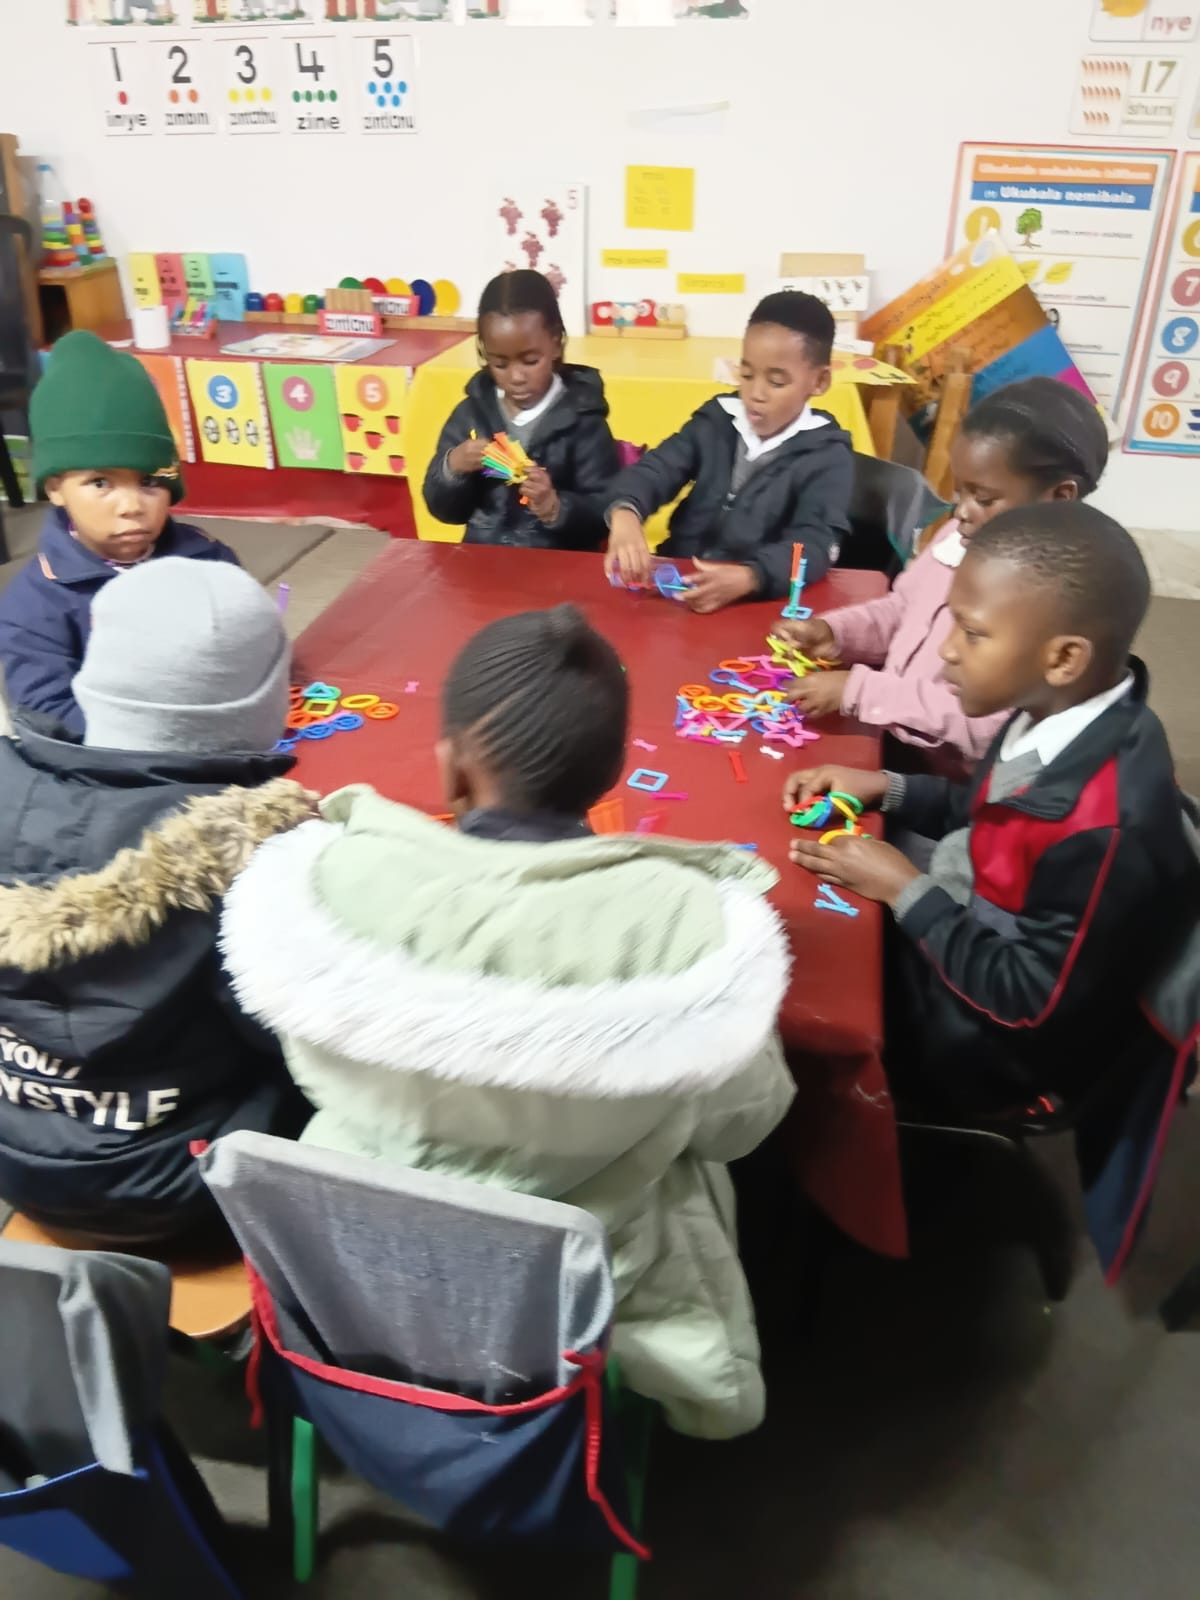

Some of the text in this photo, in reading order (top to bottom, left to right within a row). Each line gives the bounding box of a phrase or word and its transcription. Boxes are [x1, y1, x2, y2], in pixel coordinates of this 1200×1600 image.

[110, 47, 122, 81] 1
[167, 45, 192, 83] 2
[235, 45, 257, 84] 3
[296, 42, 324, 81] 4
[373, 38, 394, 78] 5
[1141, 60, 1177, 93] 17
[297, 112, 340, 130] zine
[1184, 276, 1200, 297] 7
[1171, 326, 1192, 347] 8
[1163, 369, 1182, 389] 9
[215, 385, 232, 403] 3
[289, 384, 308, 403] 4
[364, 383, 382, 403] 5
[1150, 409, 1173, 430] 10
[0, 1069, 181, 1131] YSTYLE
